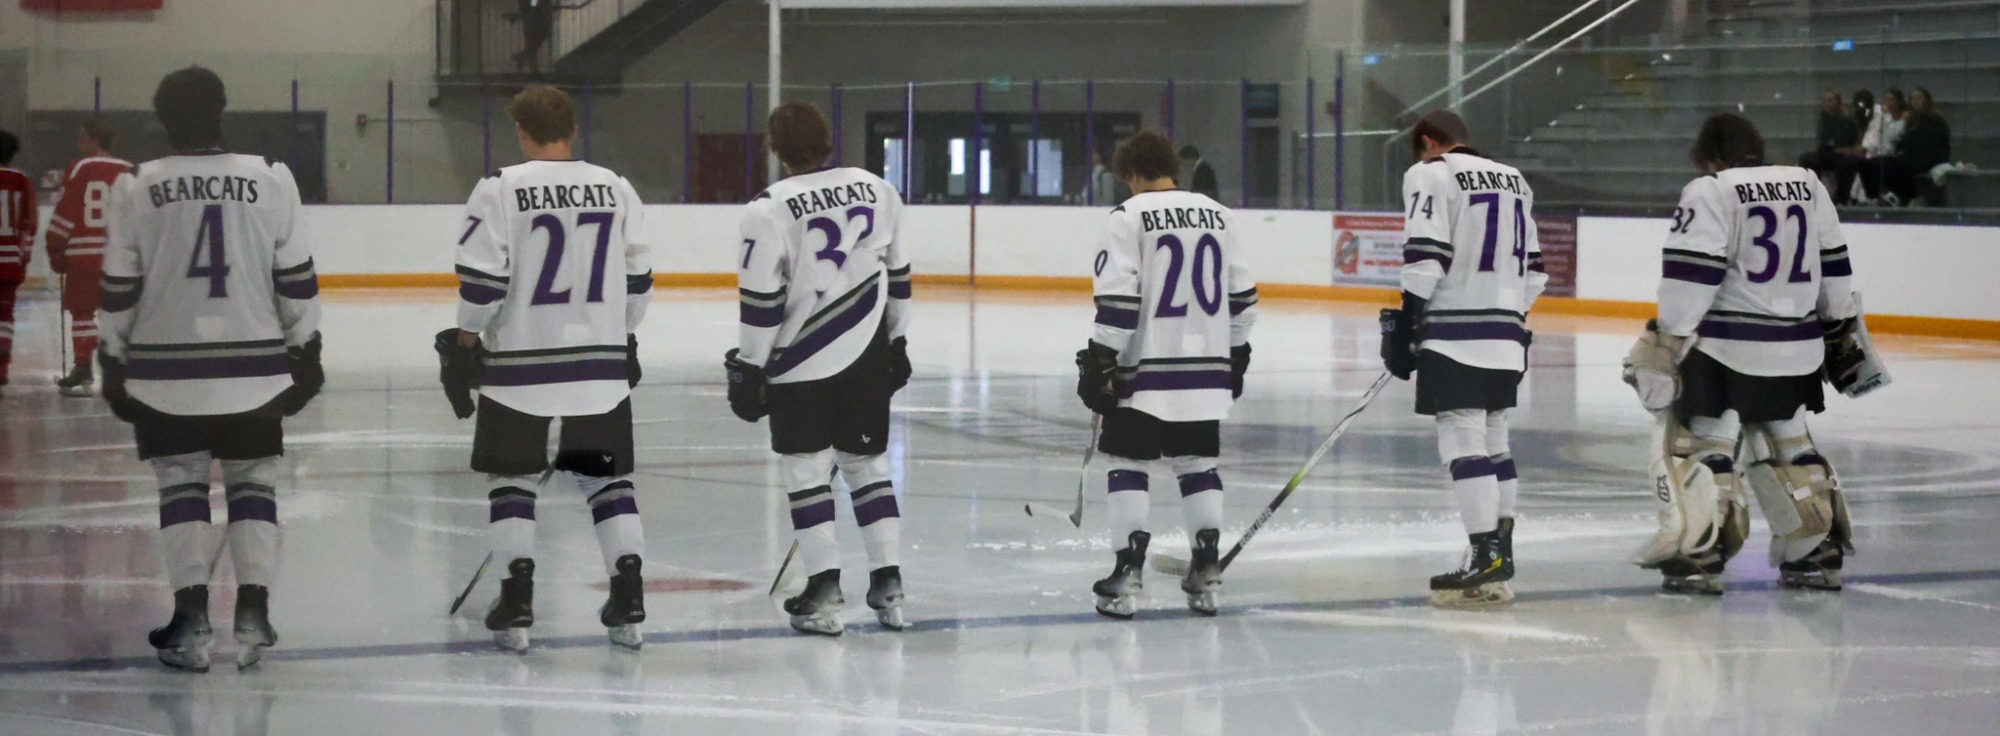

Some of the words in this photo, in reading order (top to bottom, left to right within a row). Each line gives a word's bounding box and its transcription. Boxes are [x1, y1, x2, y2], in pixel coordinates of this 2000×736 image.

[150, 175, 259, 208] BEARCATS
[515, 184, 616, 212] BEARCATS
[1455, 171, 1526, 196] BEARCAT
[1735, 181, 1812, 203] BEARCATS
[84, 181, 109, 228] 8
[786, 182, 877, 221] BEARCATS
[1408, 191, 1433, 220] 74
[458, 215, 483, 245] 7
[1141, 207, 1225, 232] BEARCATS
[1469, 193, 1526, 277] 74
[1670, 206, 1695, 234] 32
[186, 204, 231, 298] 4
[530, 212, 615, 306] 27
[742, 238, 756, 269] 7
[1746, 204, 1812, 284] 32
[1154, 233, 1222, 318] 20
